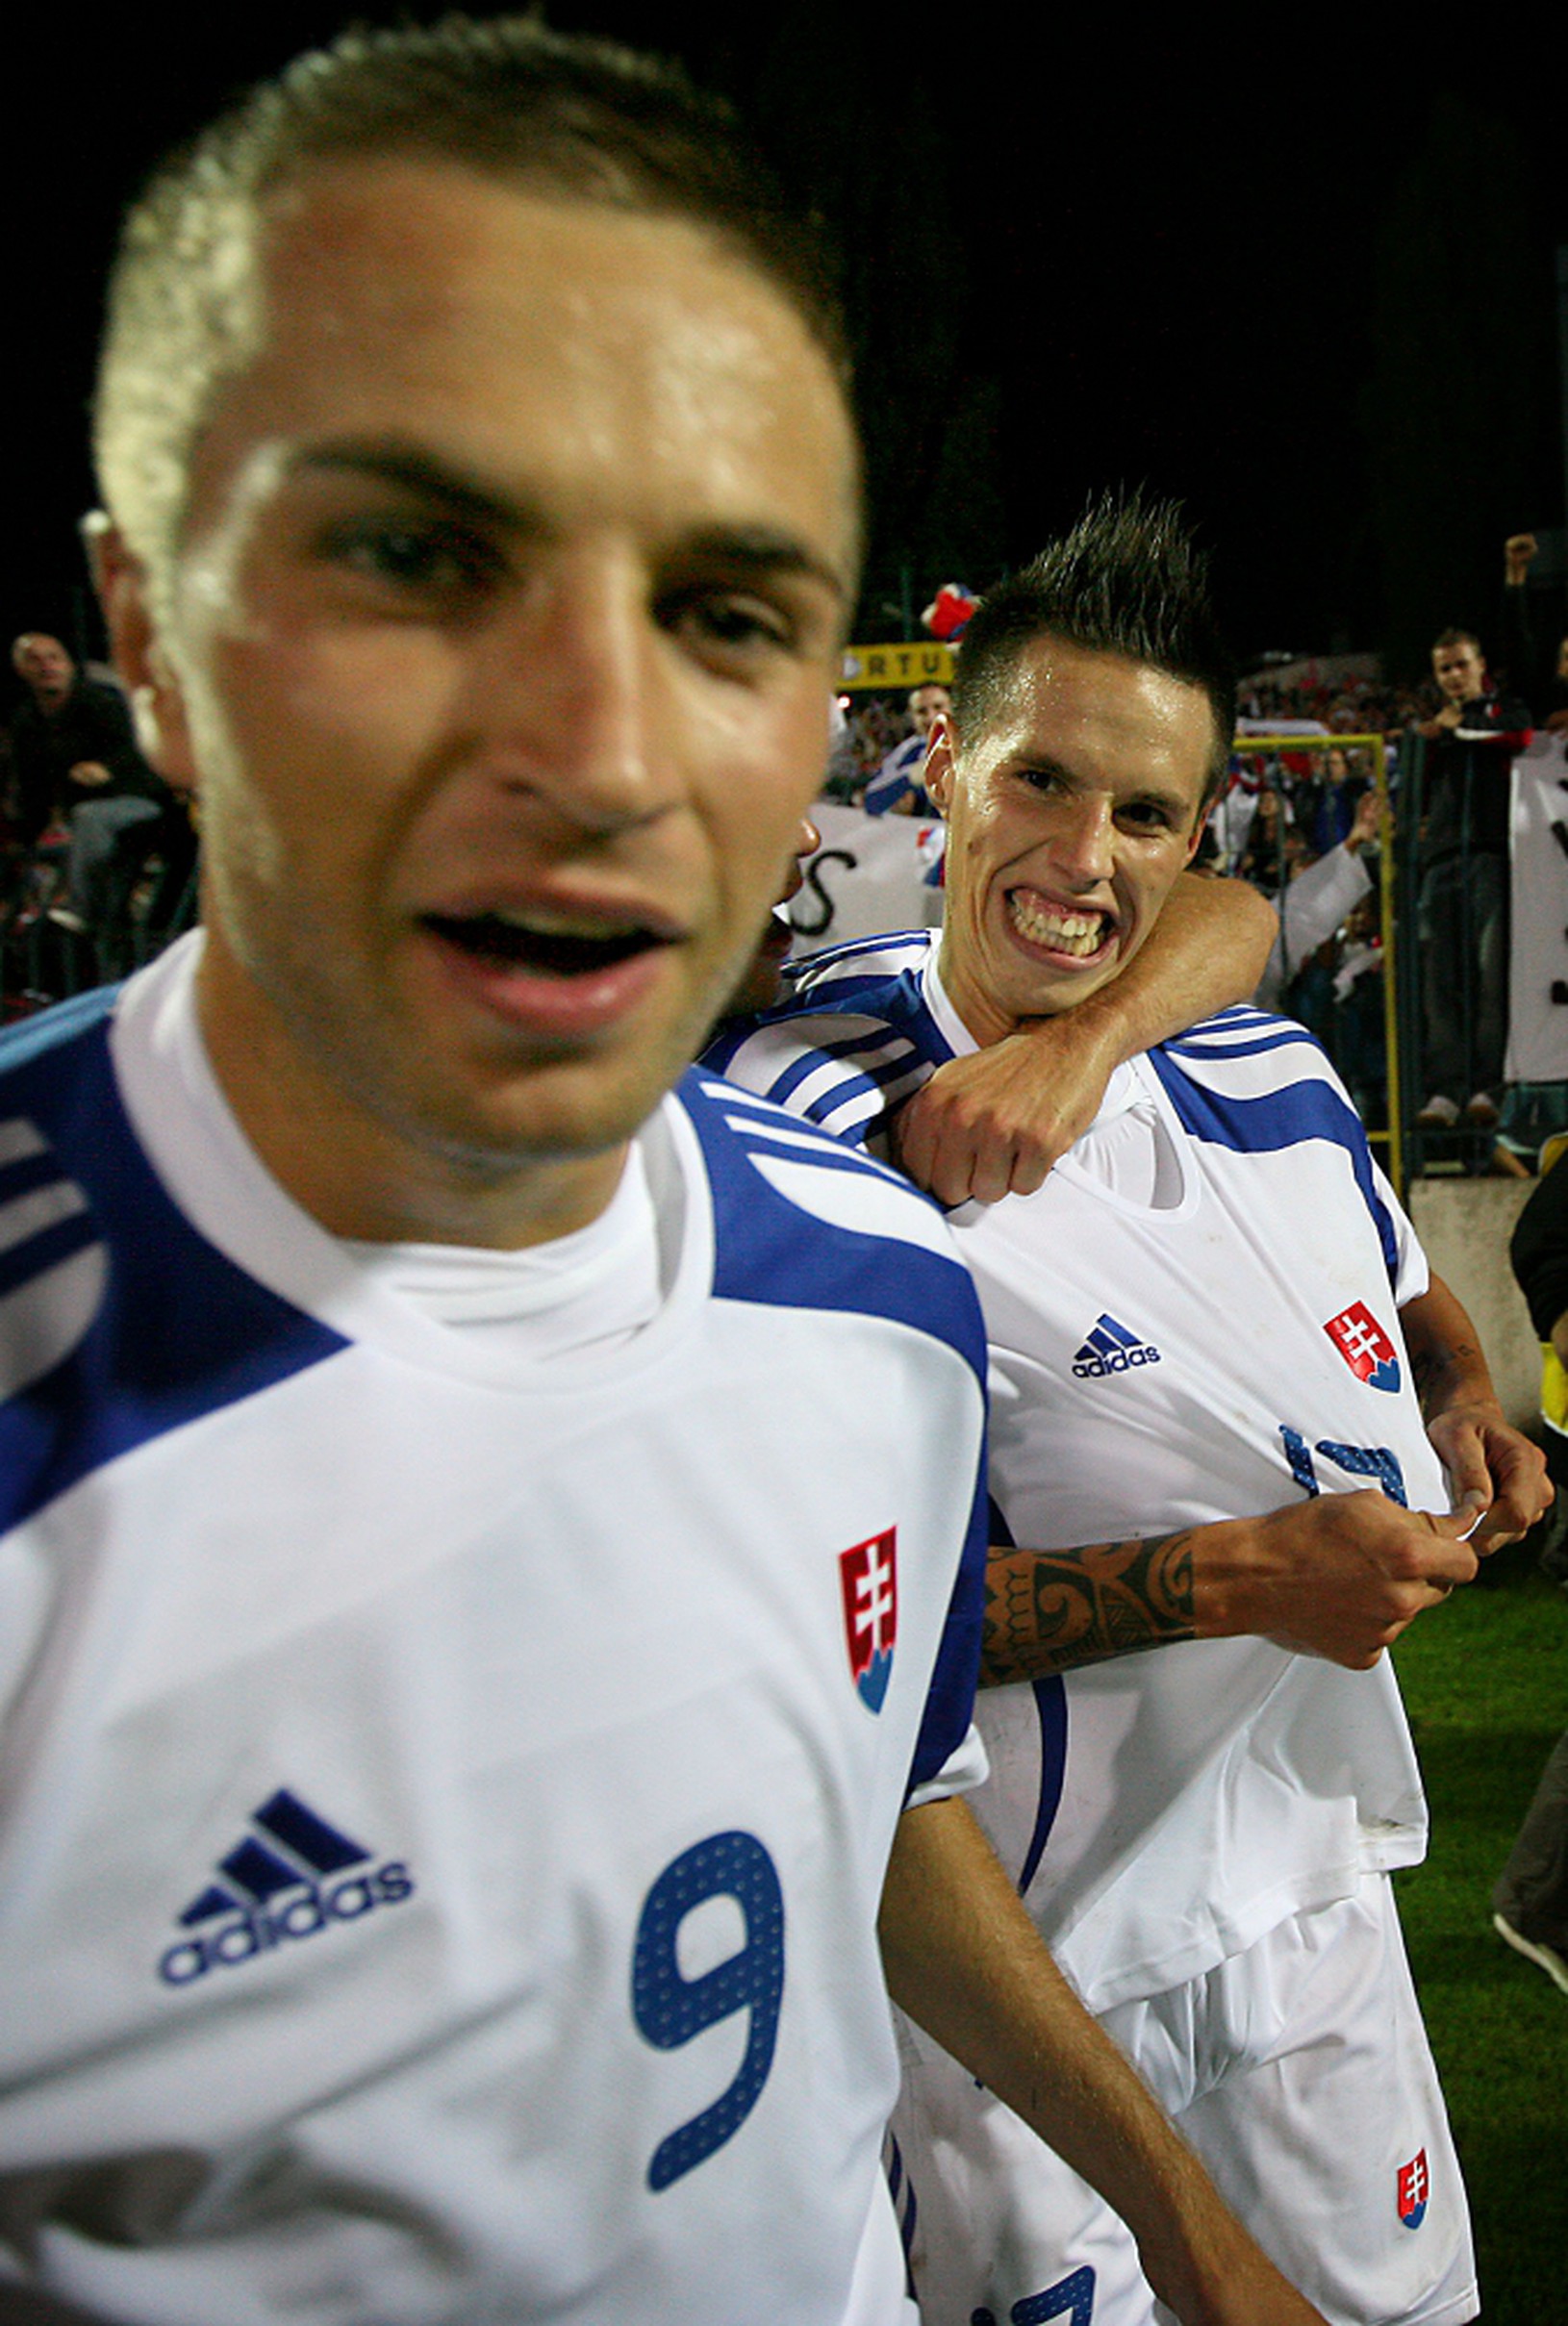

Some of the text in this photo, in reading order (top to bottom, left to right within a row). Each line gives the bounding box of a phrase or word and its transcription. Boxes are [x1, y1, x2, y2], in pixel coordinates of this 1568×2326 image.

[1072, 1345, 1161, 1378] adidas
[158, 1859, 415, 1985] adidas
[631, 1830, 784, 2193] 9
